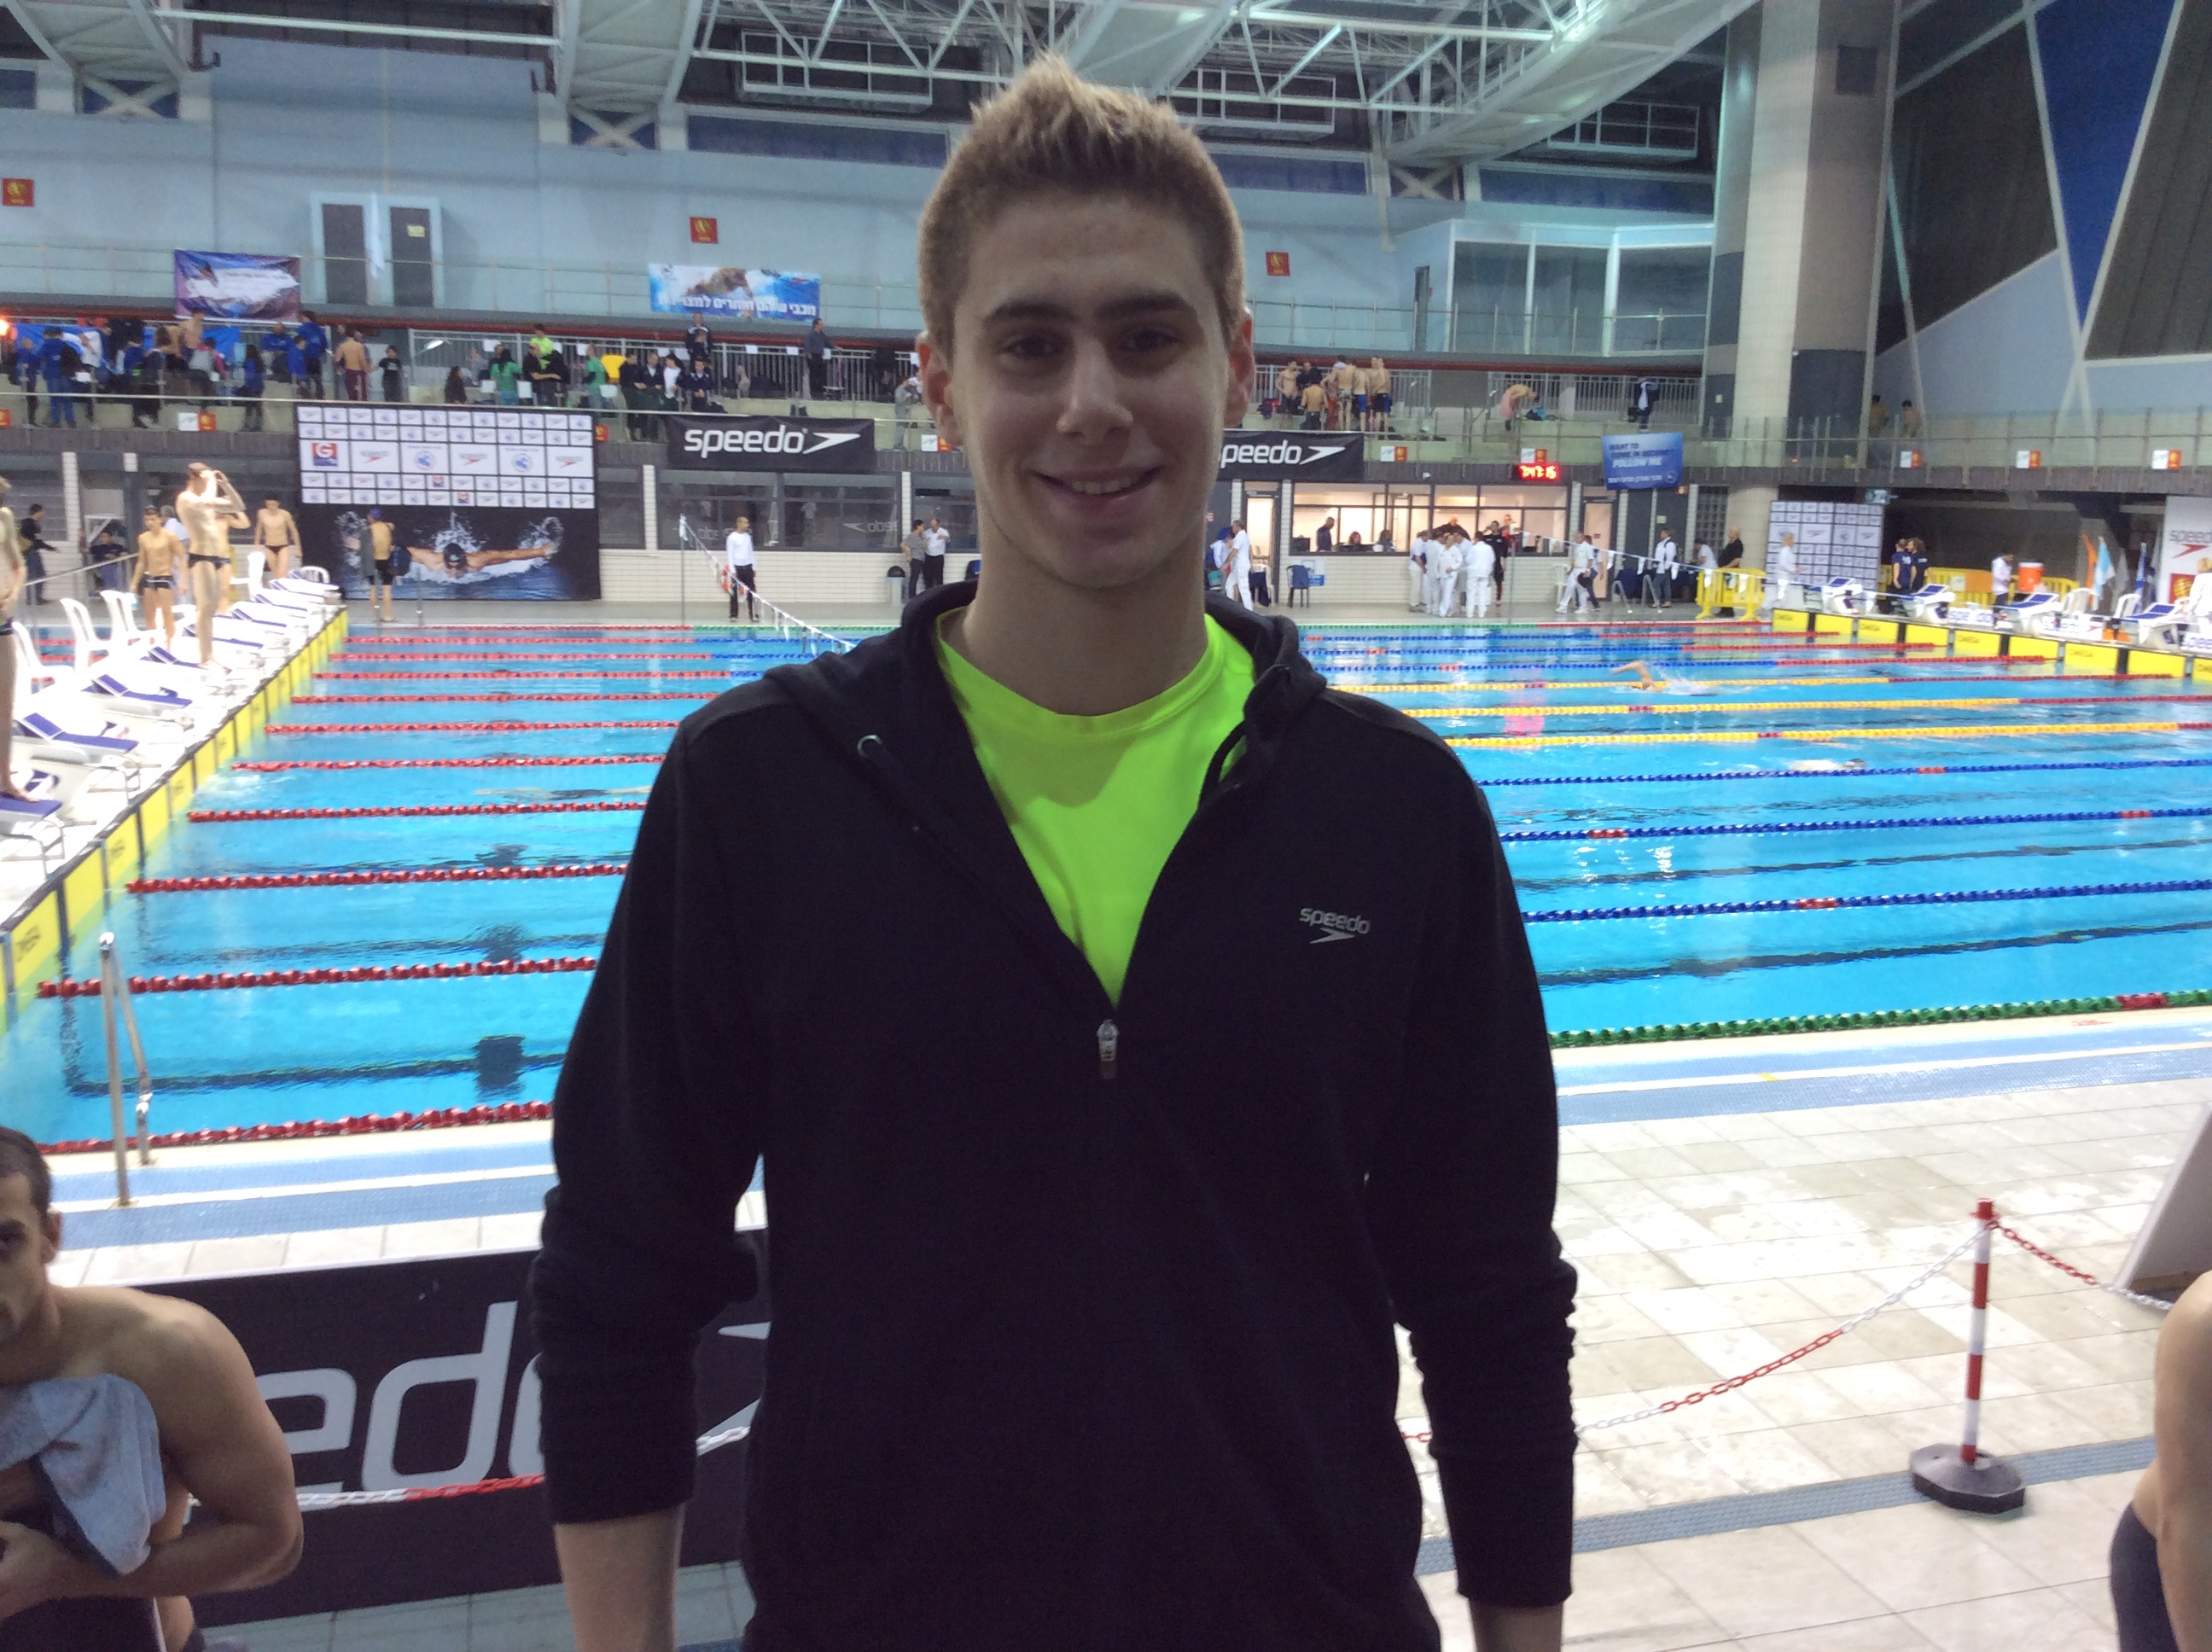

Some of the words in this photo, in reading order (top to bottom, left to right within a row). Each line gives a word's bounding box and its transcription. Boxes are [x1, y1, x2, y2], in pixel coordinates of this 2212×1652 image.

[684, 424, 802, 458] speedo
[1219, 439, 1302, 468] peedo
[1299, 907, 1371, 934] speedo
